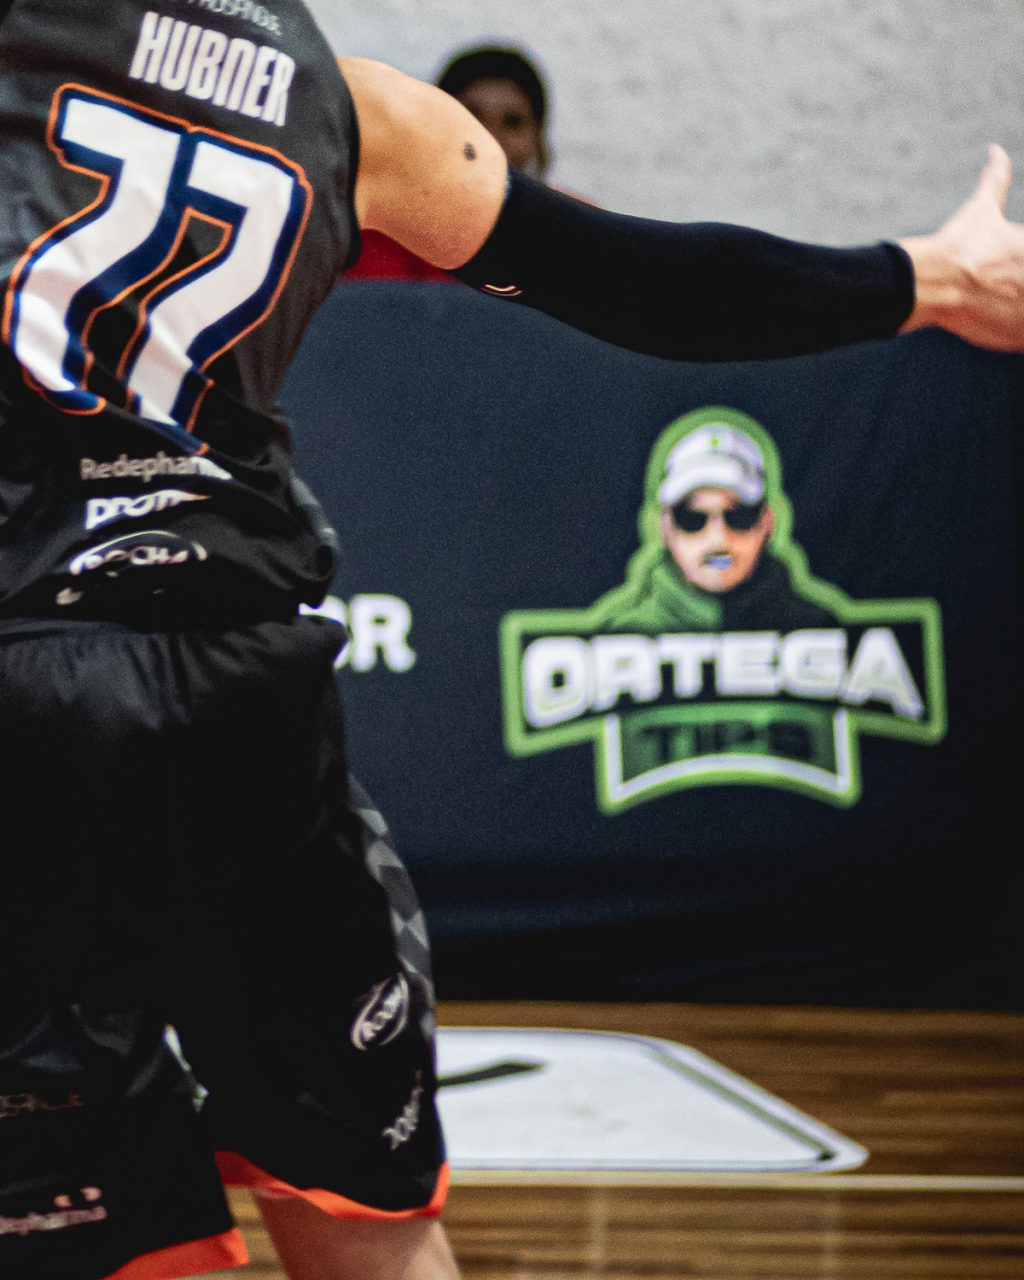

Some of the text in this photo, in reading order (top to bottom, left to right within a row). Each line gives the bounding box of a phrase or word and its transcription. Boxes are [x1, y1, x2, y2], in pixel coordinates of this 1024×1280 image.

[129, 11, 296, 127] HUBNER
[2, 82, 313, 456] 77
[522, 627, 925, 729] ORTEGA
